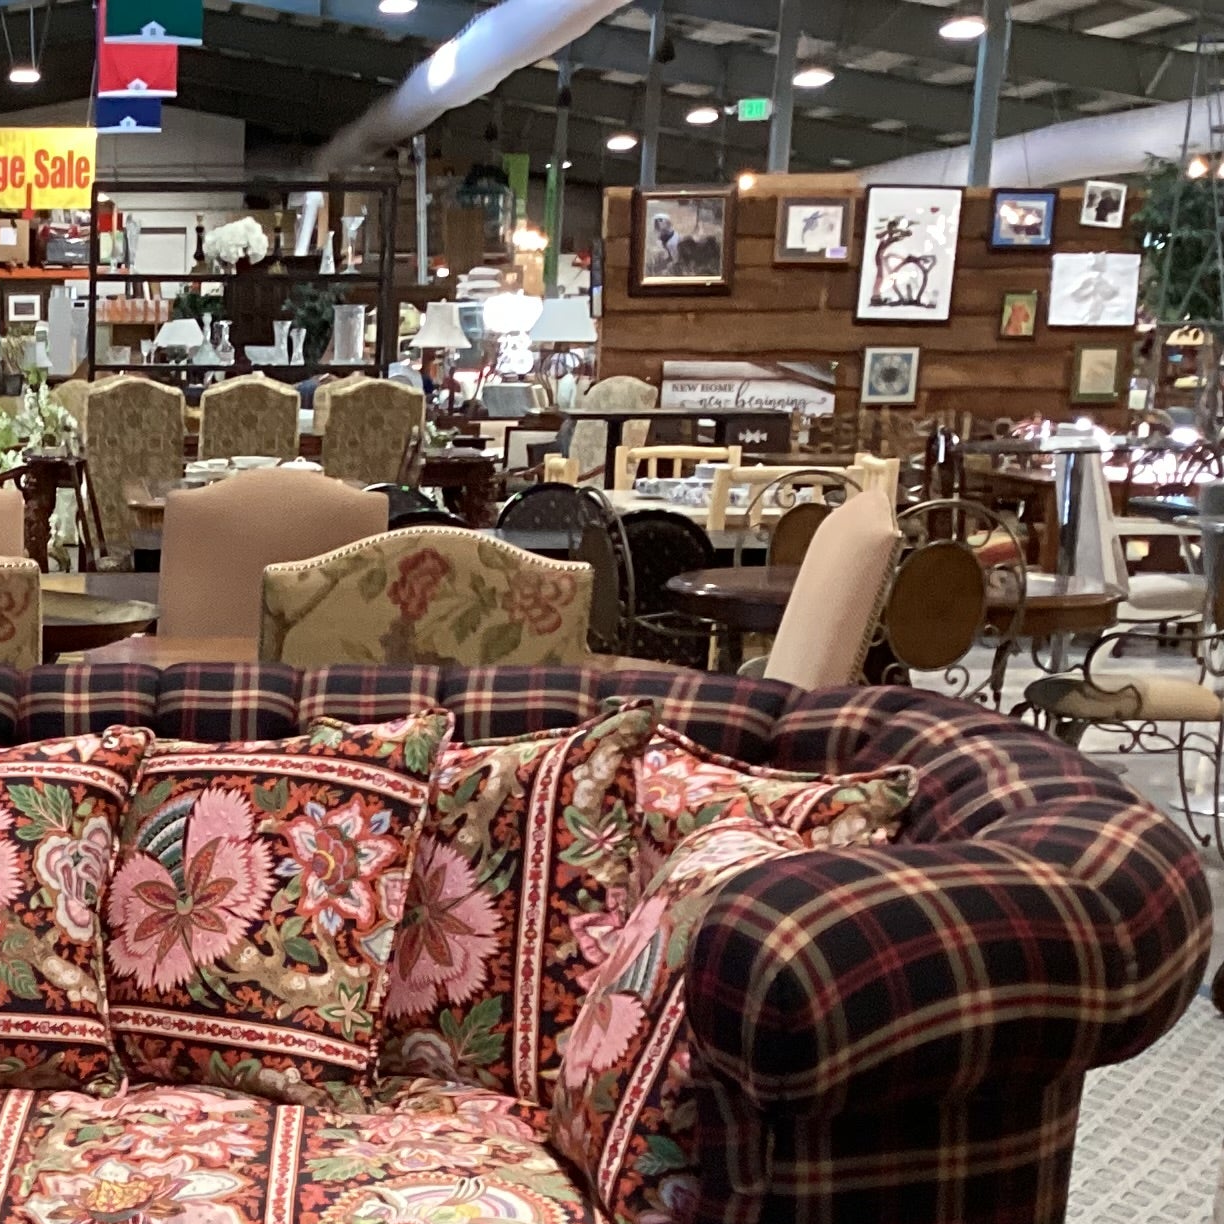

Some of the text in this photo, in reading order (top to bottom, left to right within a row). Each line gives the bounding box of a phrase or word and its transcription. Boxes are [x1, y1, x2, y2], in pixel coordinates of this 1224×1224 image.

[34, 149, 90, 189] Sale
[671, 383, 735, 392] NEW HOME
